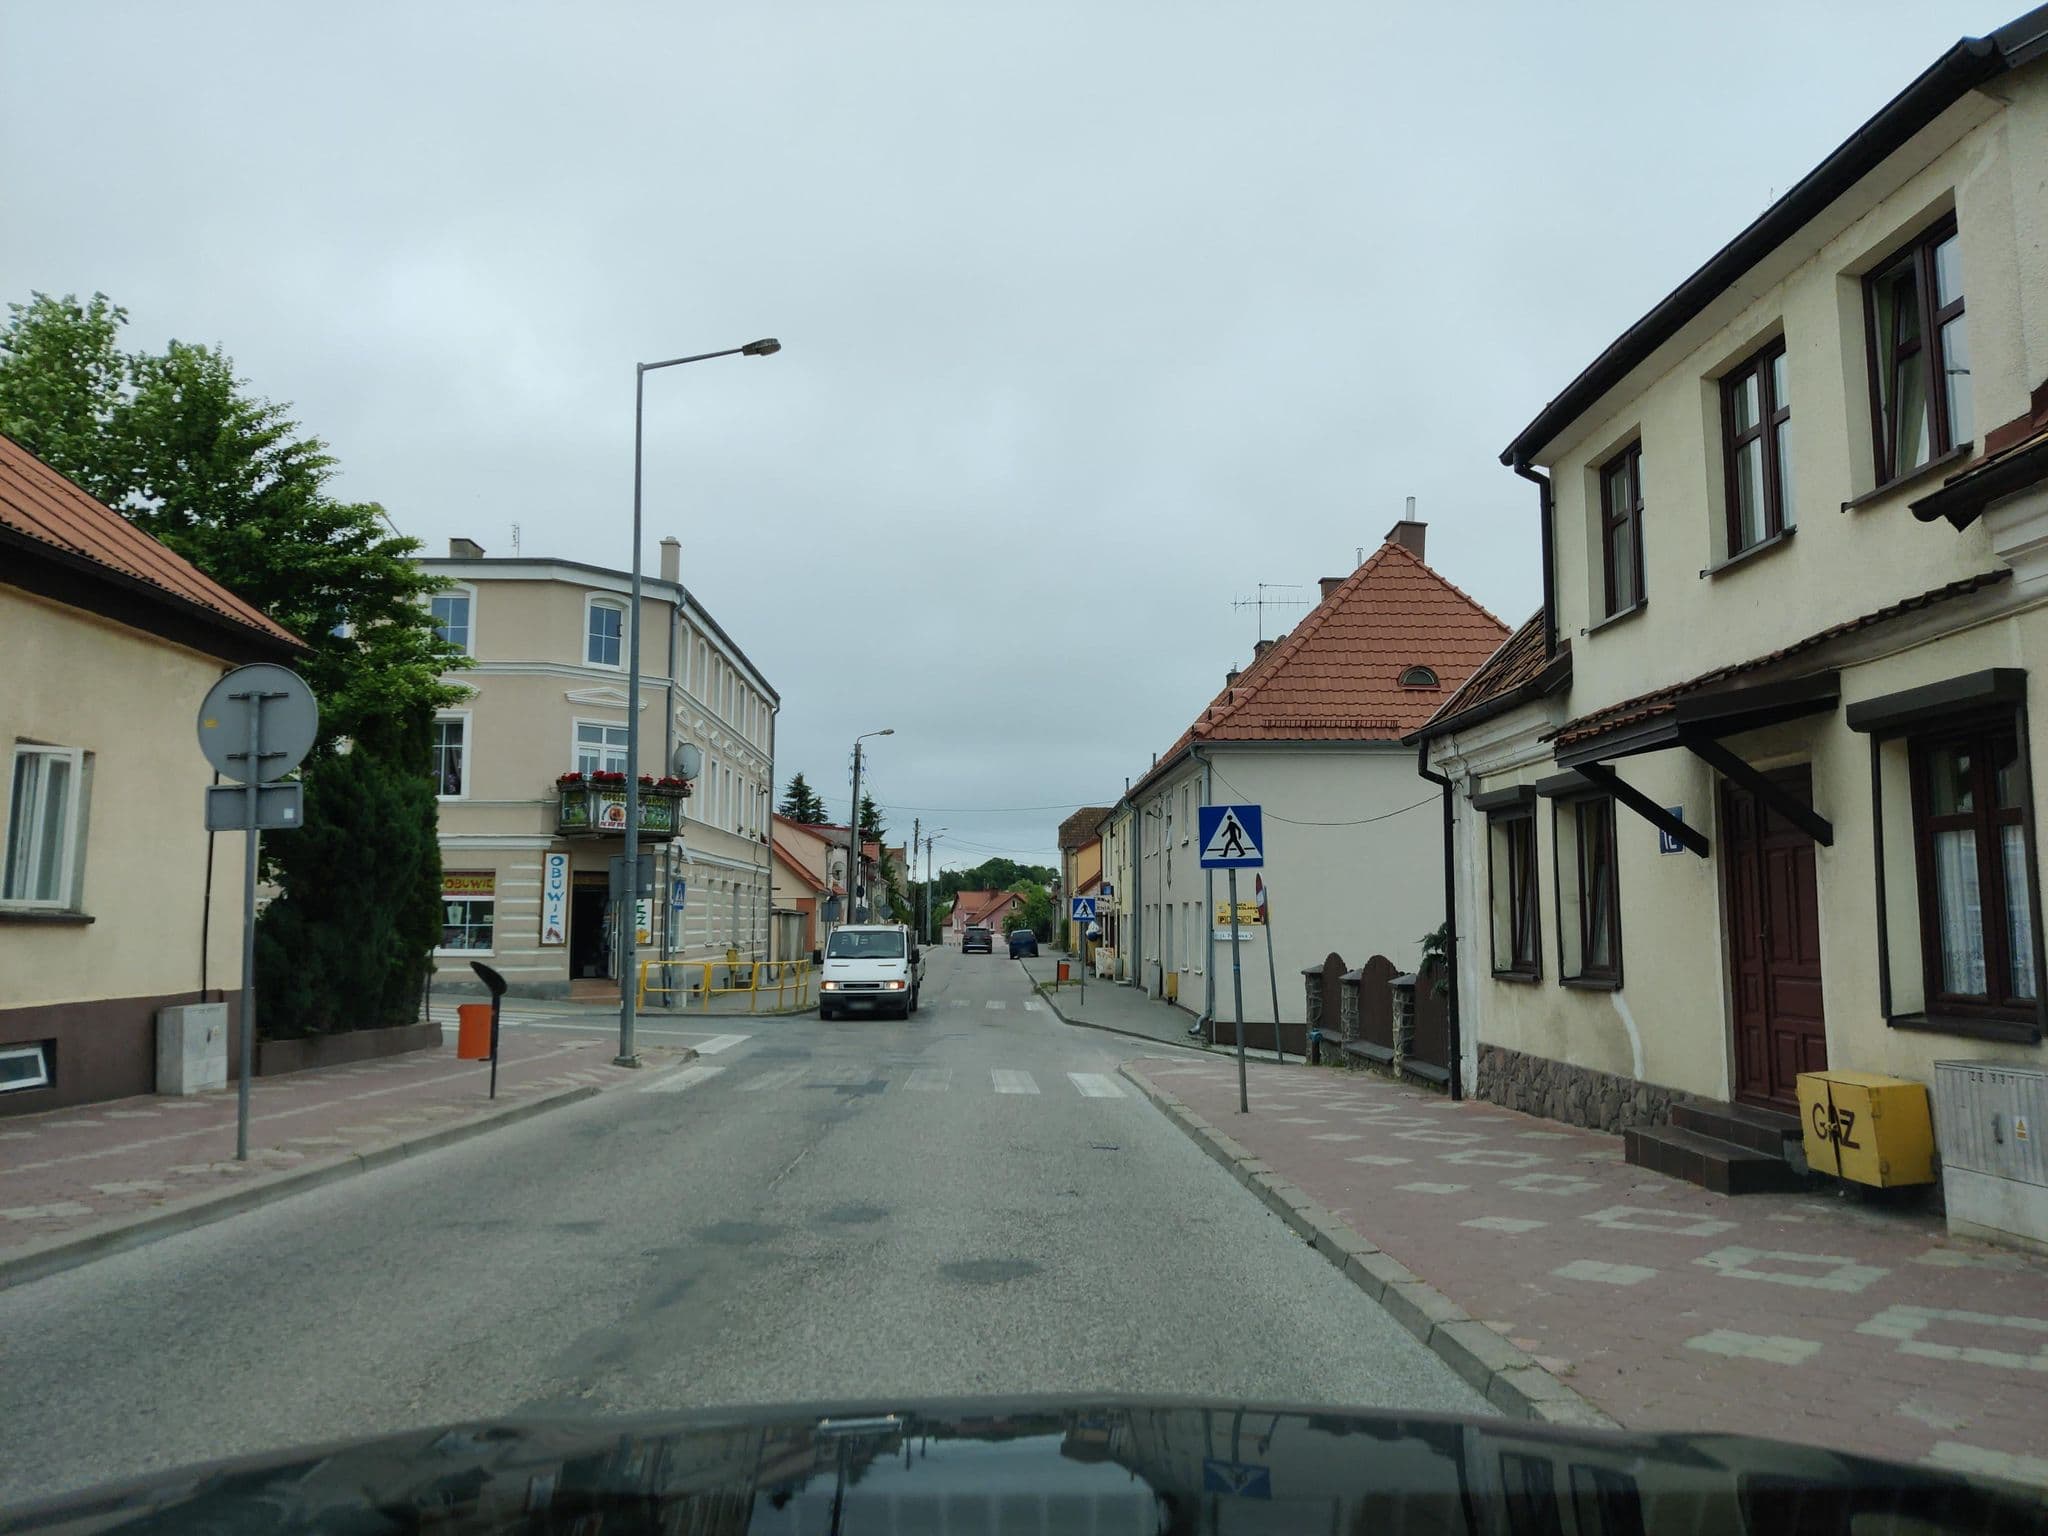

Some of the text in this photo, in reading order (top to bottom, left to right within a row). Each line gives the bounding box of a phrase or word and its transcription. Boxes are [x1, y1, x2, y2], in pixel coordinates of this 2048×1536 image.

[444, 876, 493, 889] OBUWIE
[547, 855, 565, 925] OBUWIE
[1812, 1103, 1861, 1150] GAZ
